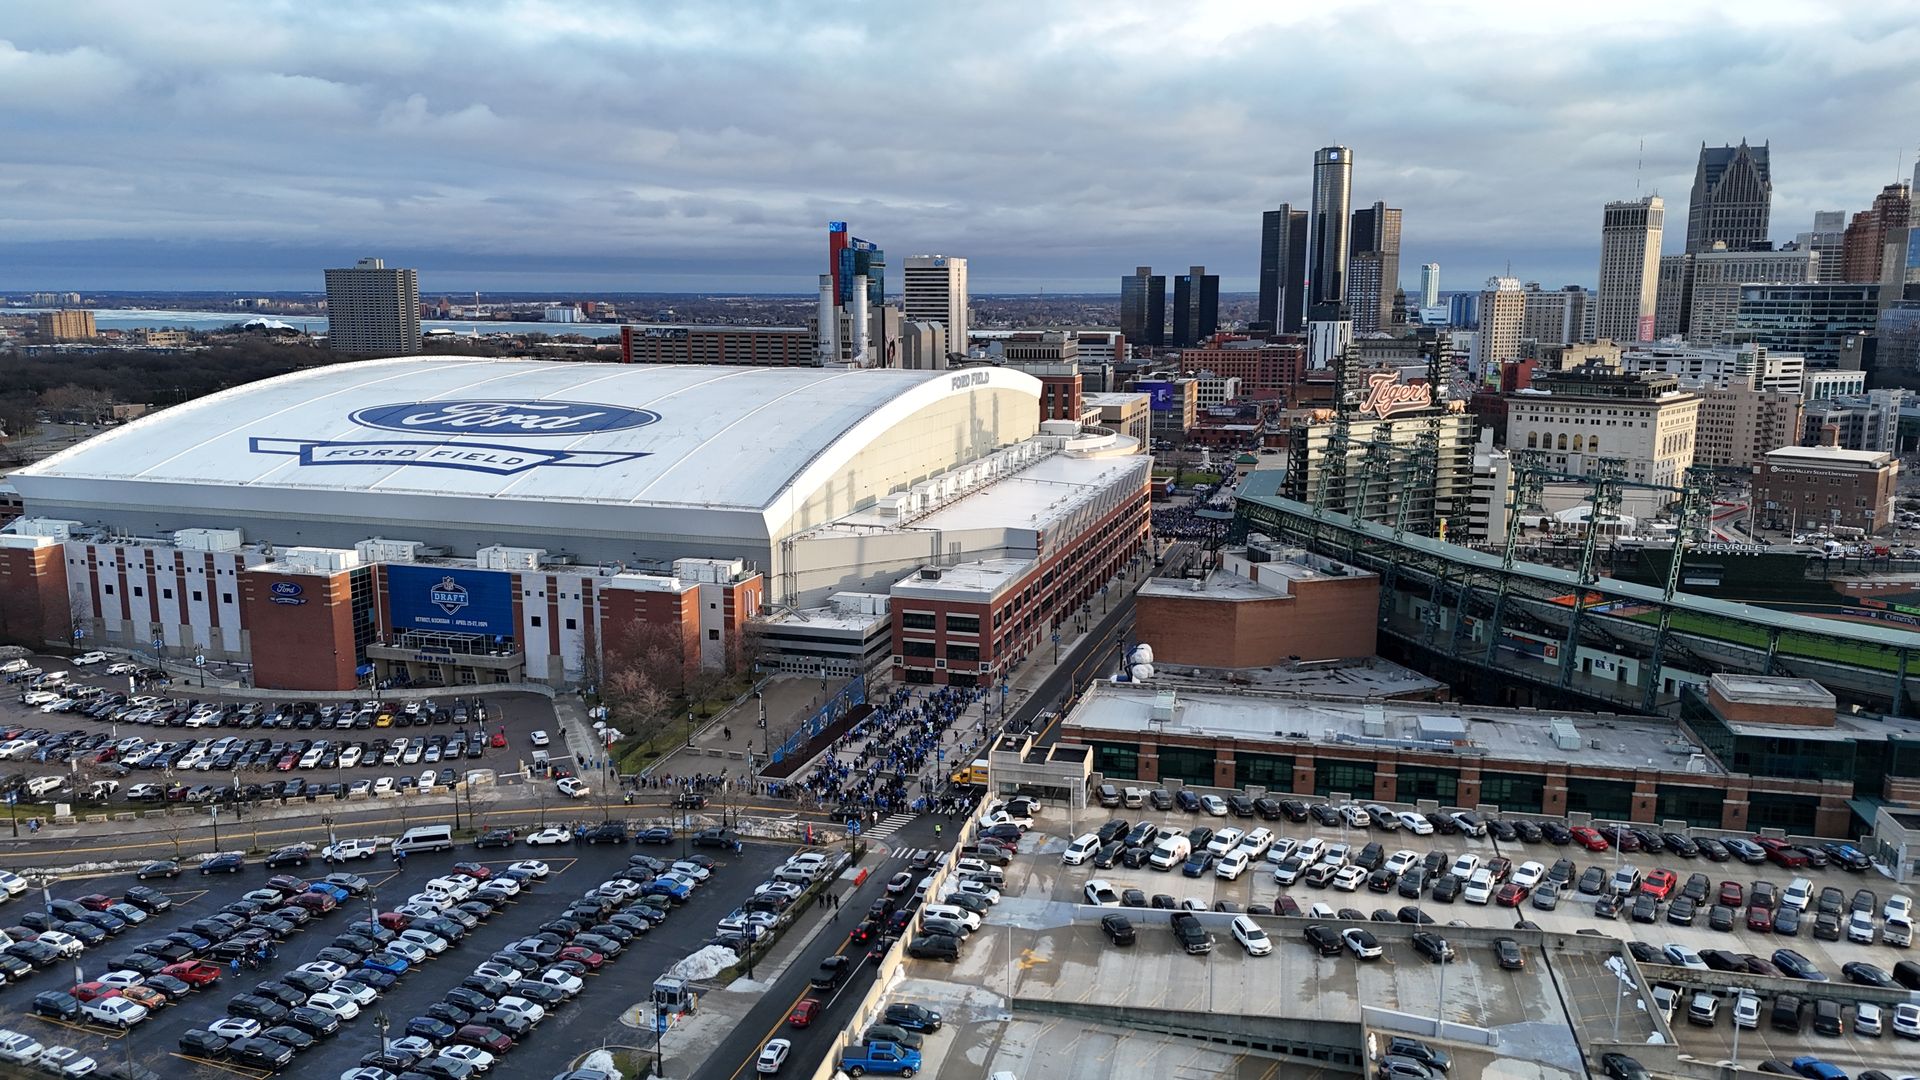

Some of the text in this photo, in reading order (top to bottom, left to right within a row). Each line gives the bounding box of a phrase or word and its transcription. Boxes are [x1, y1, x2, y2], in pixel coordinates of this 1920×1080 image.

[951, 371, 990, 391] FORD FIELD
[1359, 371, 1432, 420] Tigers
[402, 402, 606, 430] Ford
[324, 448, 525, 466] FORD FIELD
[1700, 542, 1770, 551] CHEVROLET
[276, 583, 295, 594] Ford
[434, 593, 465, 602] DRAFT
